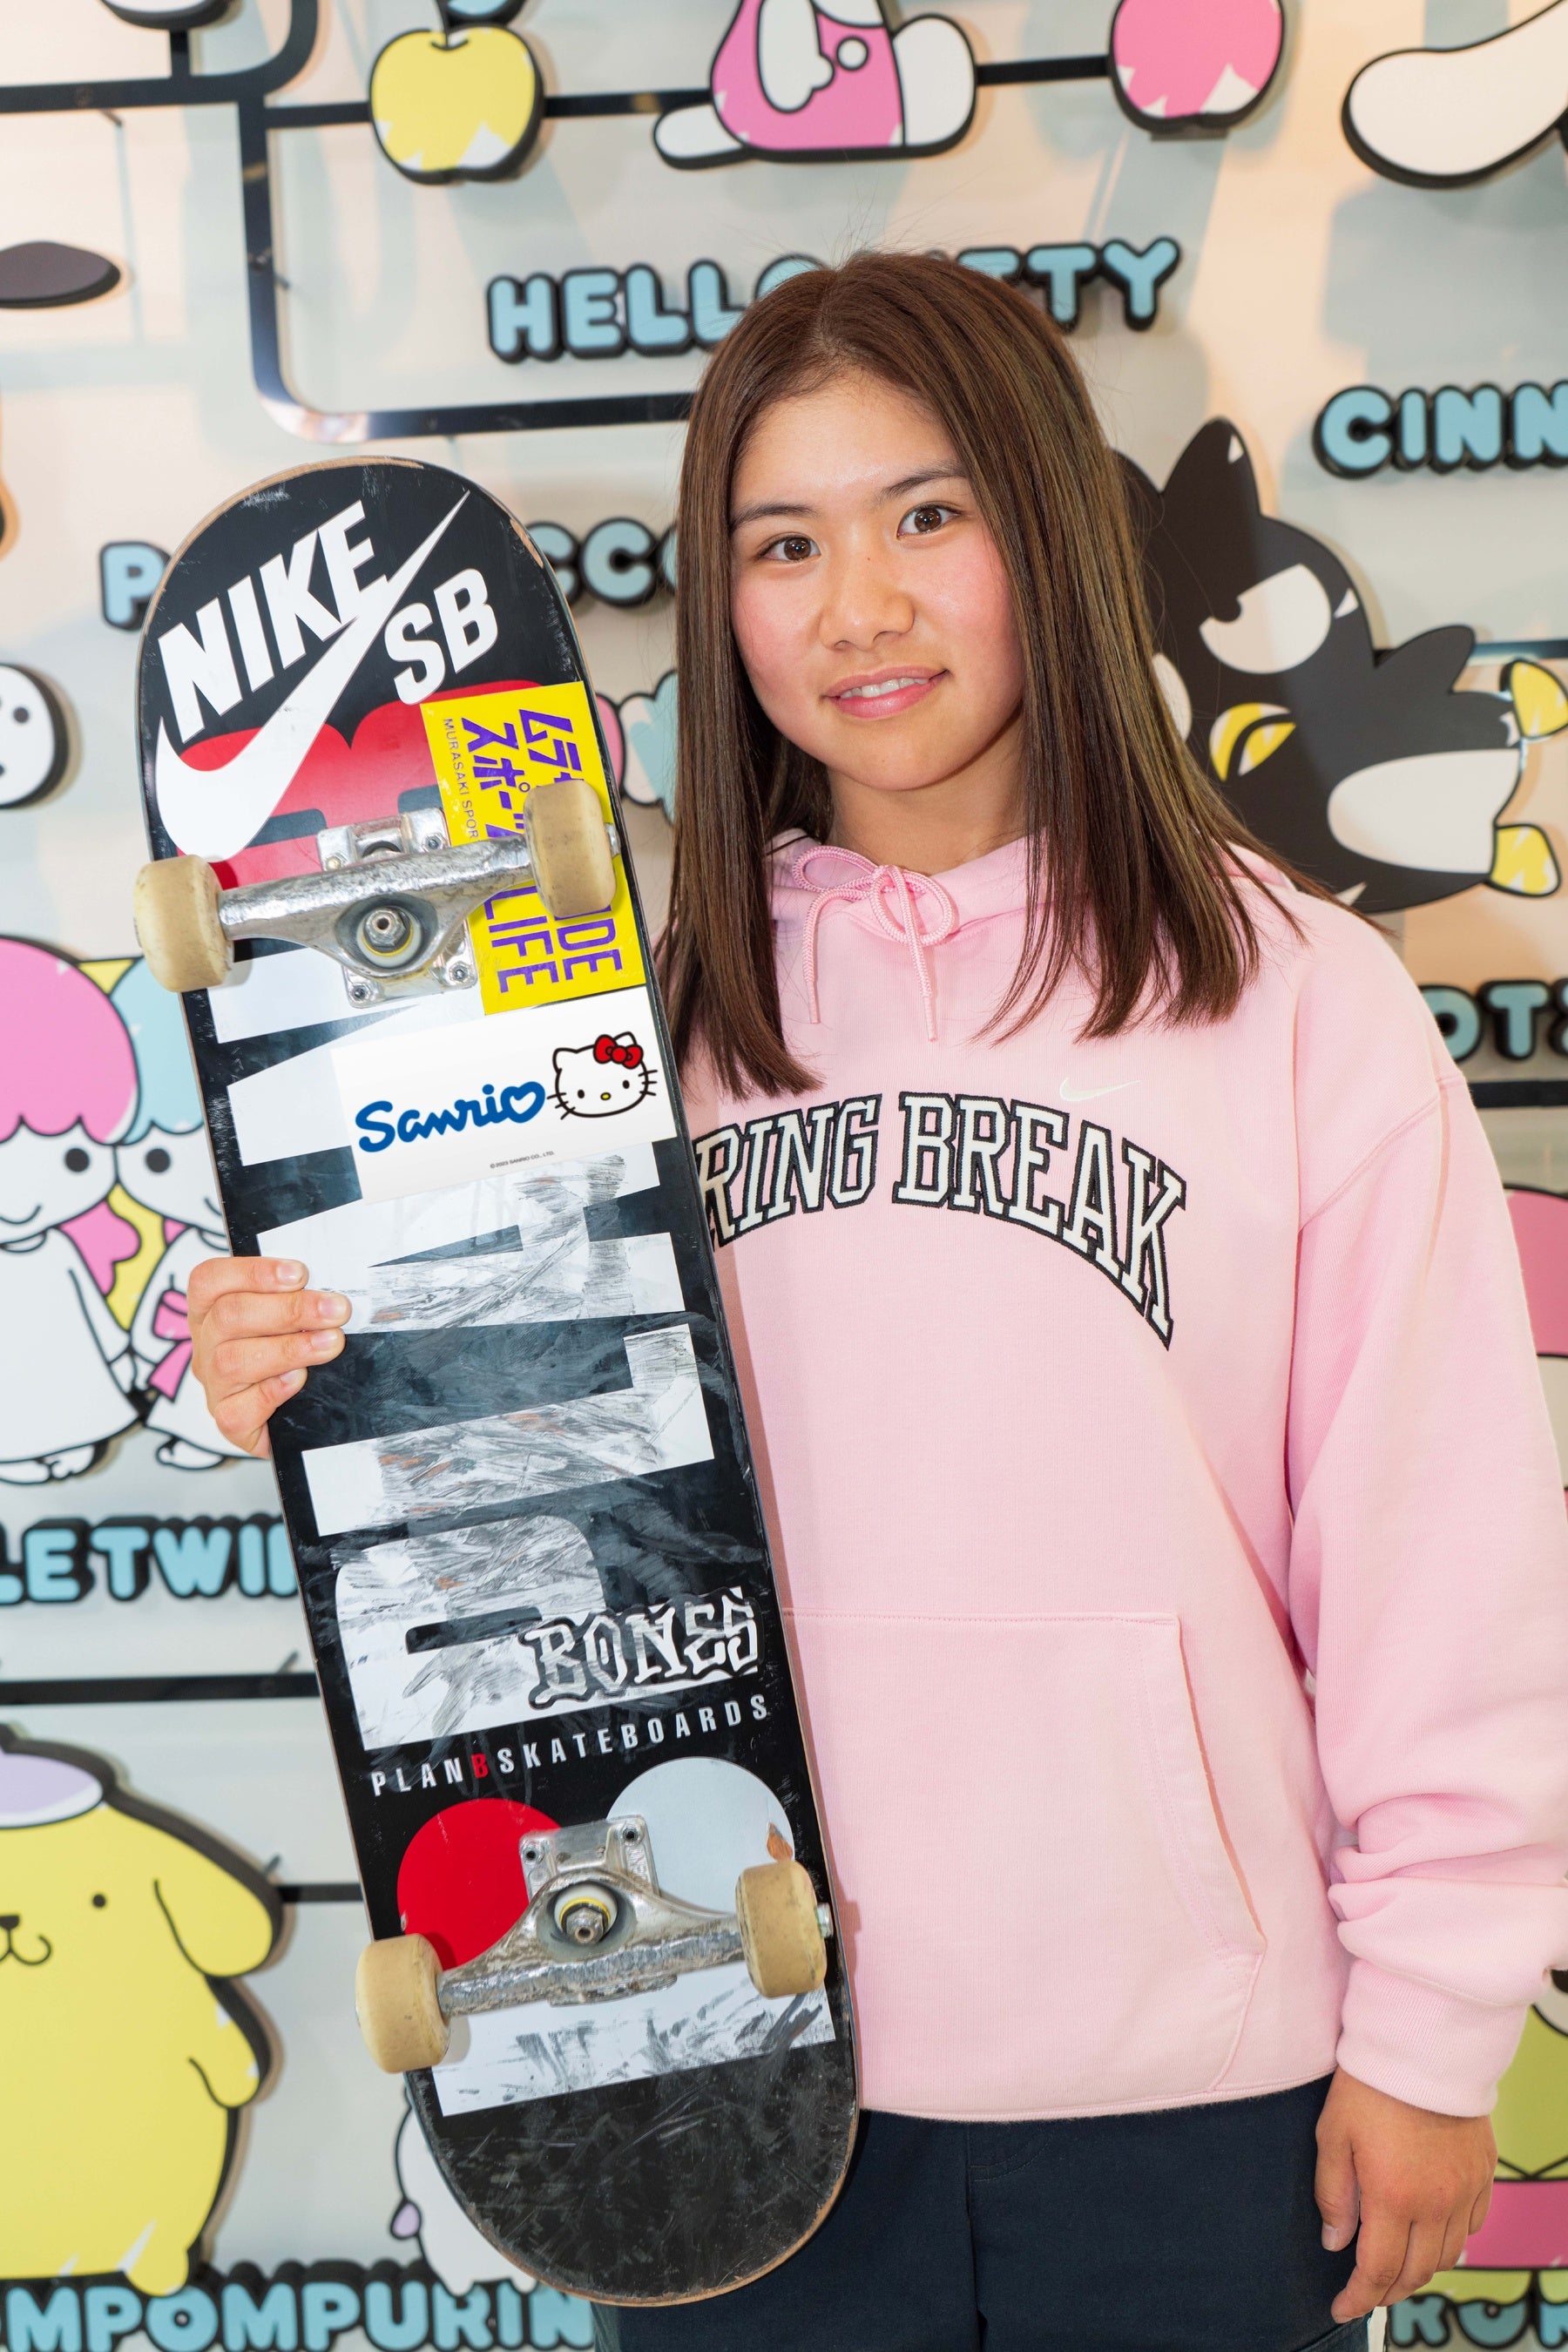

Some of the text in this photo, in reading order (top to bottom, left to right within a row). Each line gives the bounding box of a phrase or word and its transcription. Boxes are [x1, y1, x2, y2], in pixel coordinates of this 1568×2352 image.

[158, 499, 390, 745] NIKE
[384, 568, 498, 706] SB
[443, 718, 479, 842] MURASAKI SPOR
[519, 708, 585, 787] ムラ
[483, 885, 559, 994] LIFE
[355, 1081, 546, 1152] Sanrio
[509, 1155, 531, 1165] SANRIO
[891, 1091, 1186, 1351] BREAK
[524, 1594, 760, 1707] BONES
